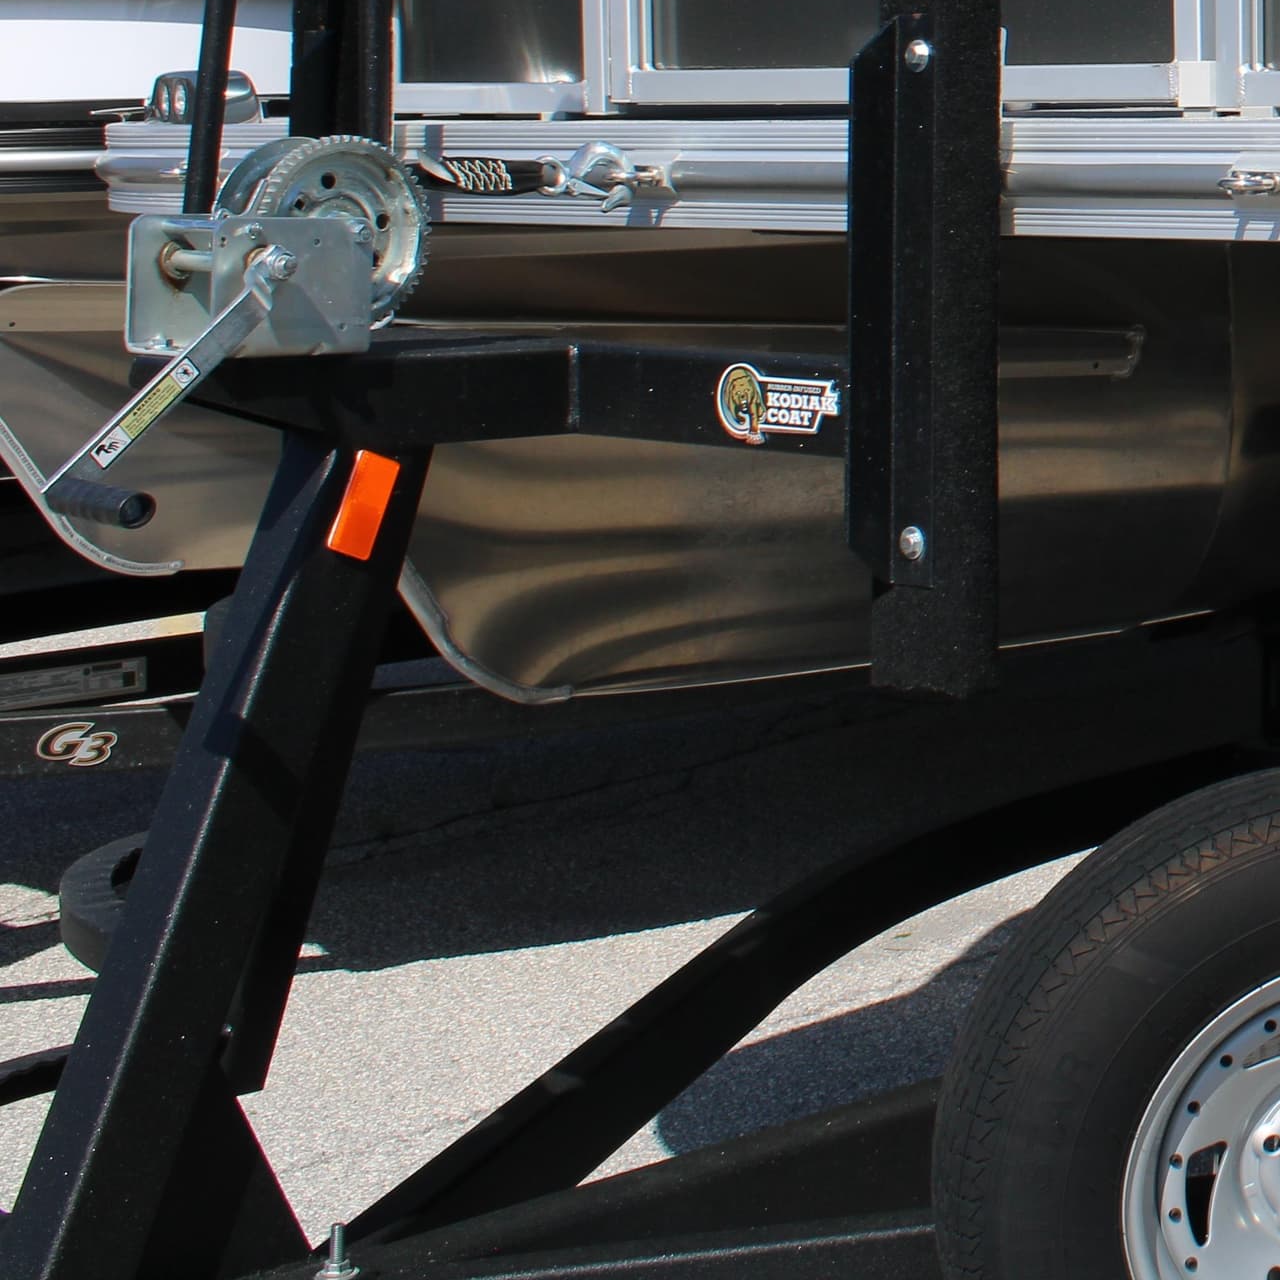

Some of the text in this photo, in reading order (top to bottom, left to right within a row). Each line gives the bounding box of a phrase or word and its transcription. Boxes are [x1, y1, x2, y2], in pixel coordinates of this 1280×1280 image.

[766, 392, 837, 412] KODIAK
[766, 409, 812, 426] COAT
[36, 721, 119, 767] G3
